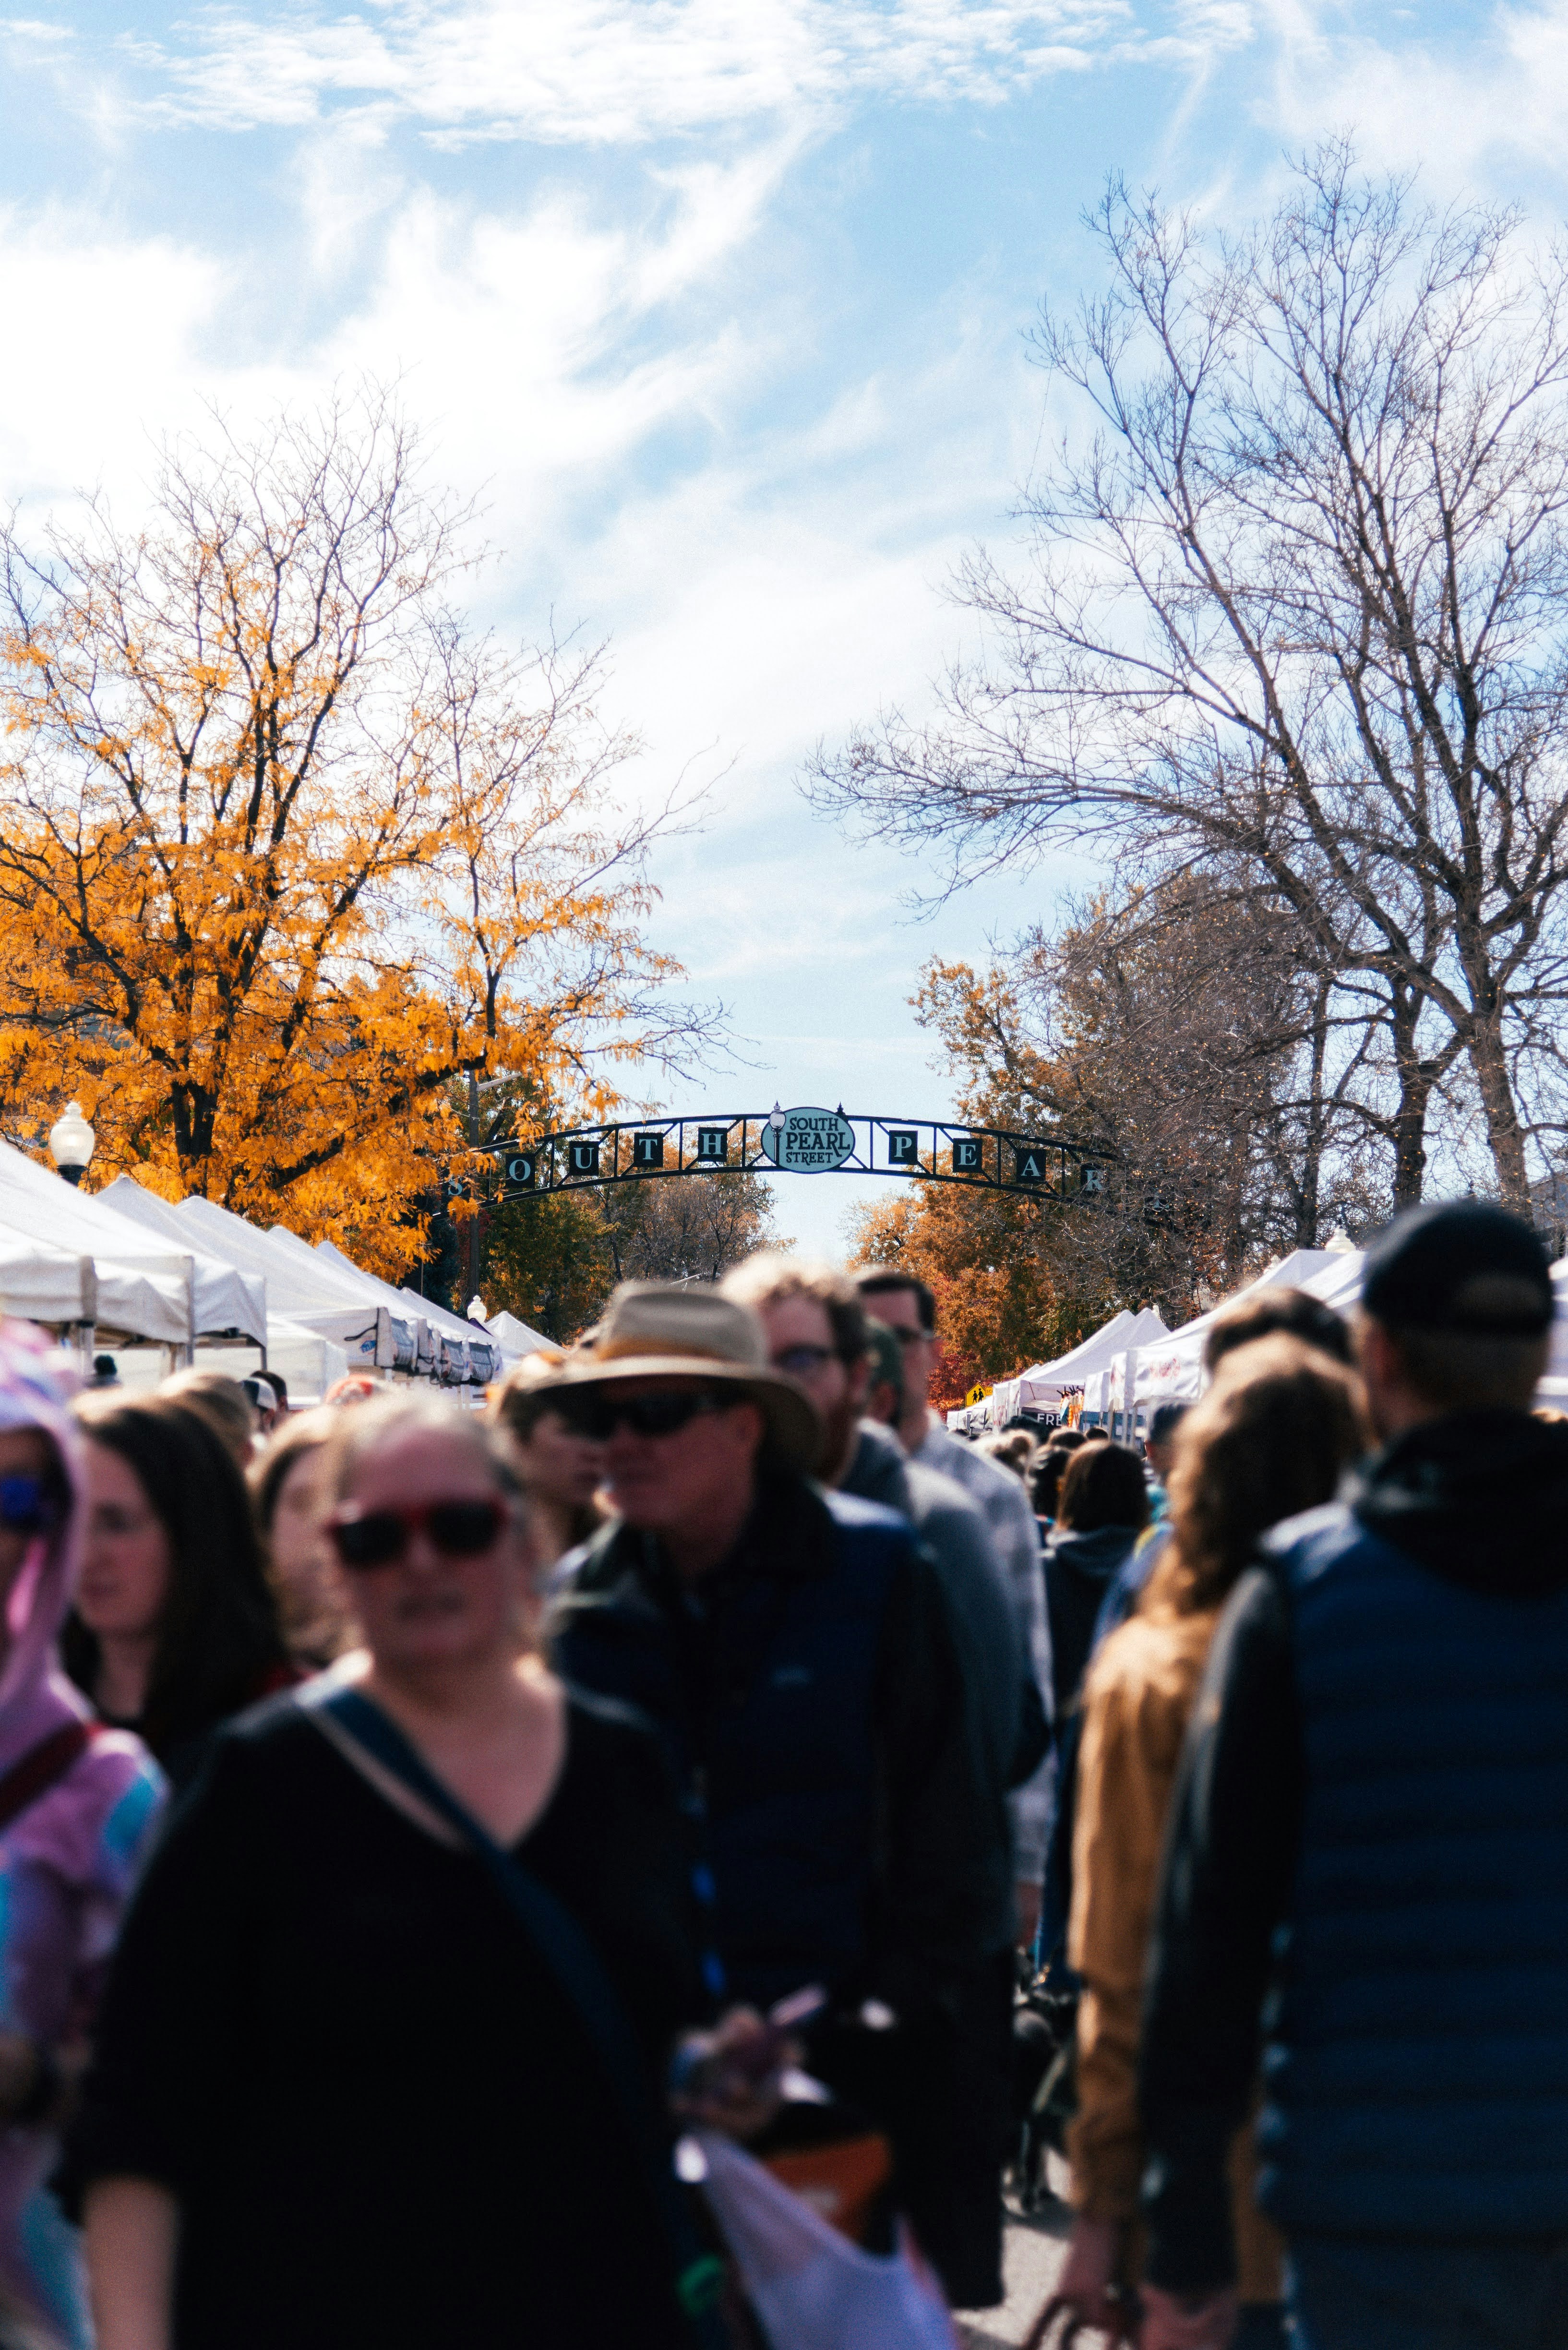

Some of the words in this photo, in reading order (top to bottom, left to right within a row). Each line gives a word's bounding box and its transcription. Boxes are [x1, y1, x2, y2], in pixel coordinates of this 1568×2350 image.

[790, 1117, 838, 1131] SOUTH
[786, 1132, 850, 1157] PEARL
[448, 1133, 724, 1196] SOUTH
[786, 1151, 833, 1165] STREET
